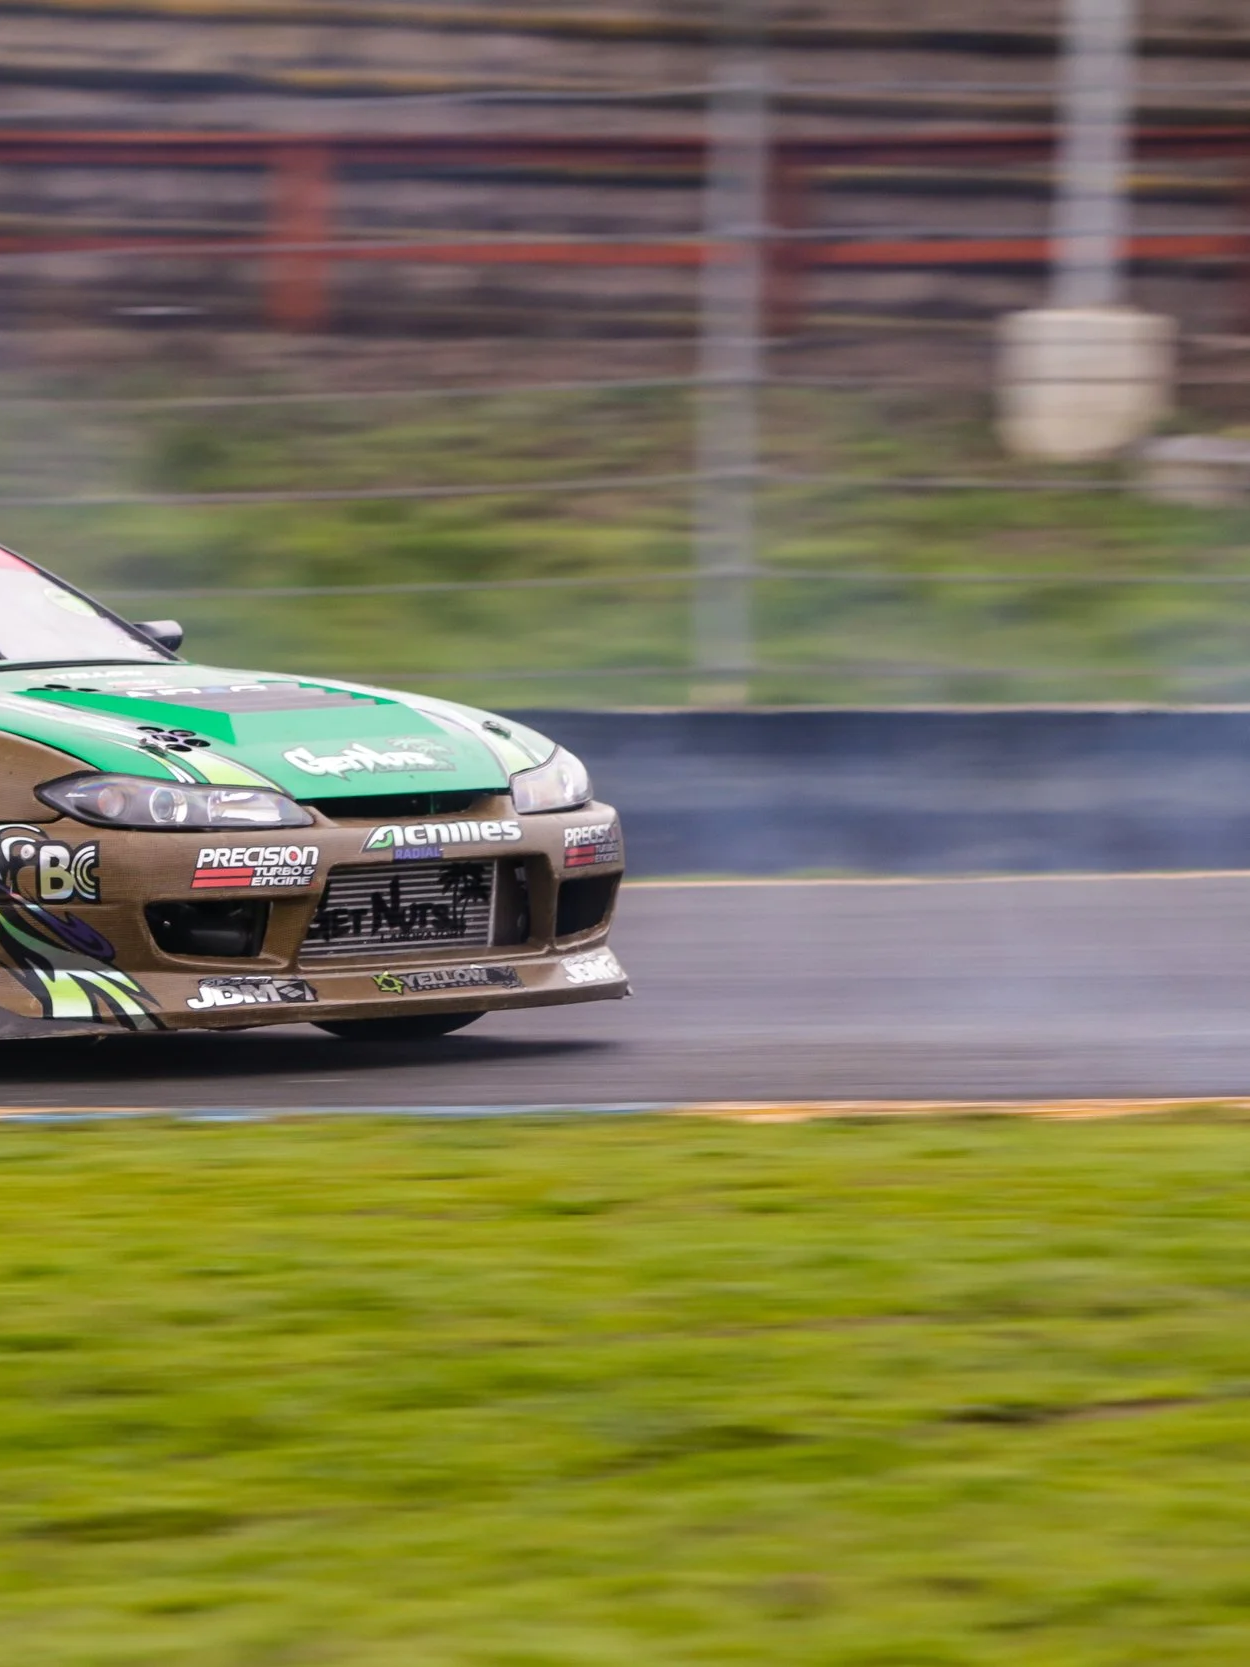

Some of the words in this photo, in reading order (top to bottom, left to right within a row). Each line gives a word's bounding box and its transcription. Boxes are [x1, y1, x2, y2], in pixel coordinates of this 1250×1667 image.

[362, 820, 523, 849] Achilles
[196, 846, 320, 868] PRECISION
[394, 847, 442, 860] RADIAL
[251, 876, 311, 887] ENGINE
[254, 867, 303, 876] TURBO
[401, 967, 488, 987] YELLOW
[186, 984, 283, 1009] JDM
